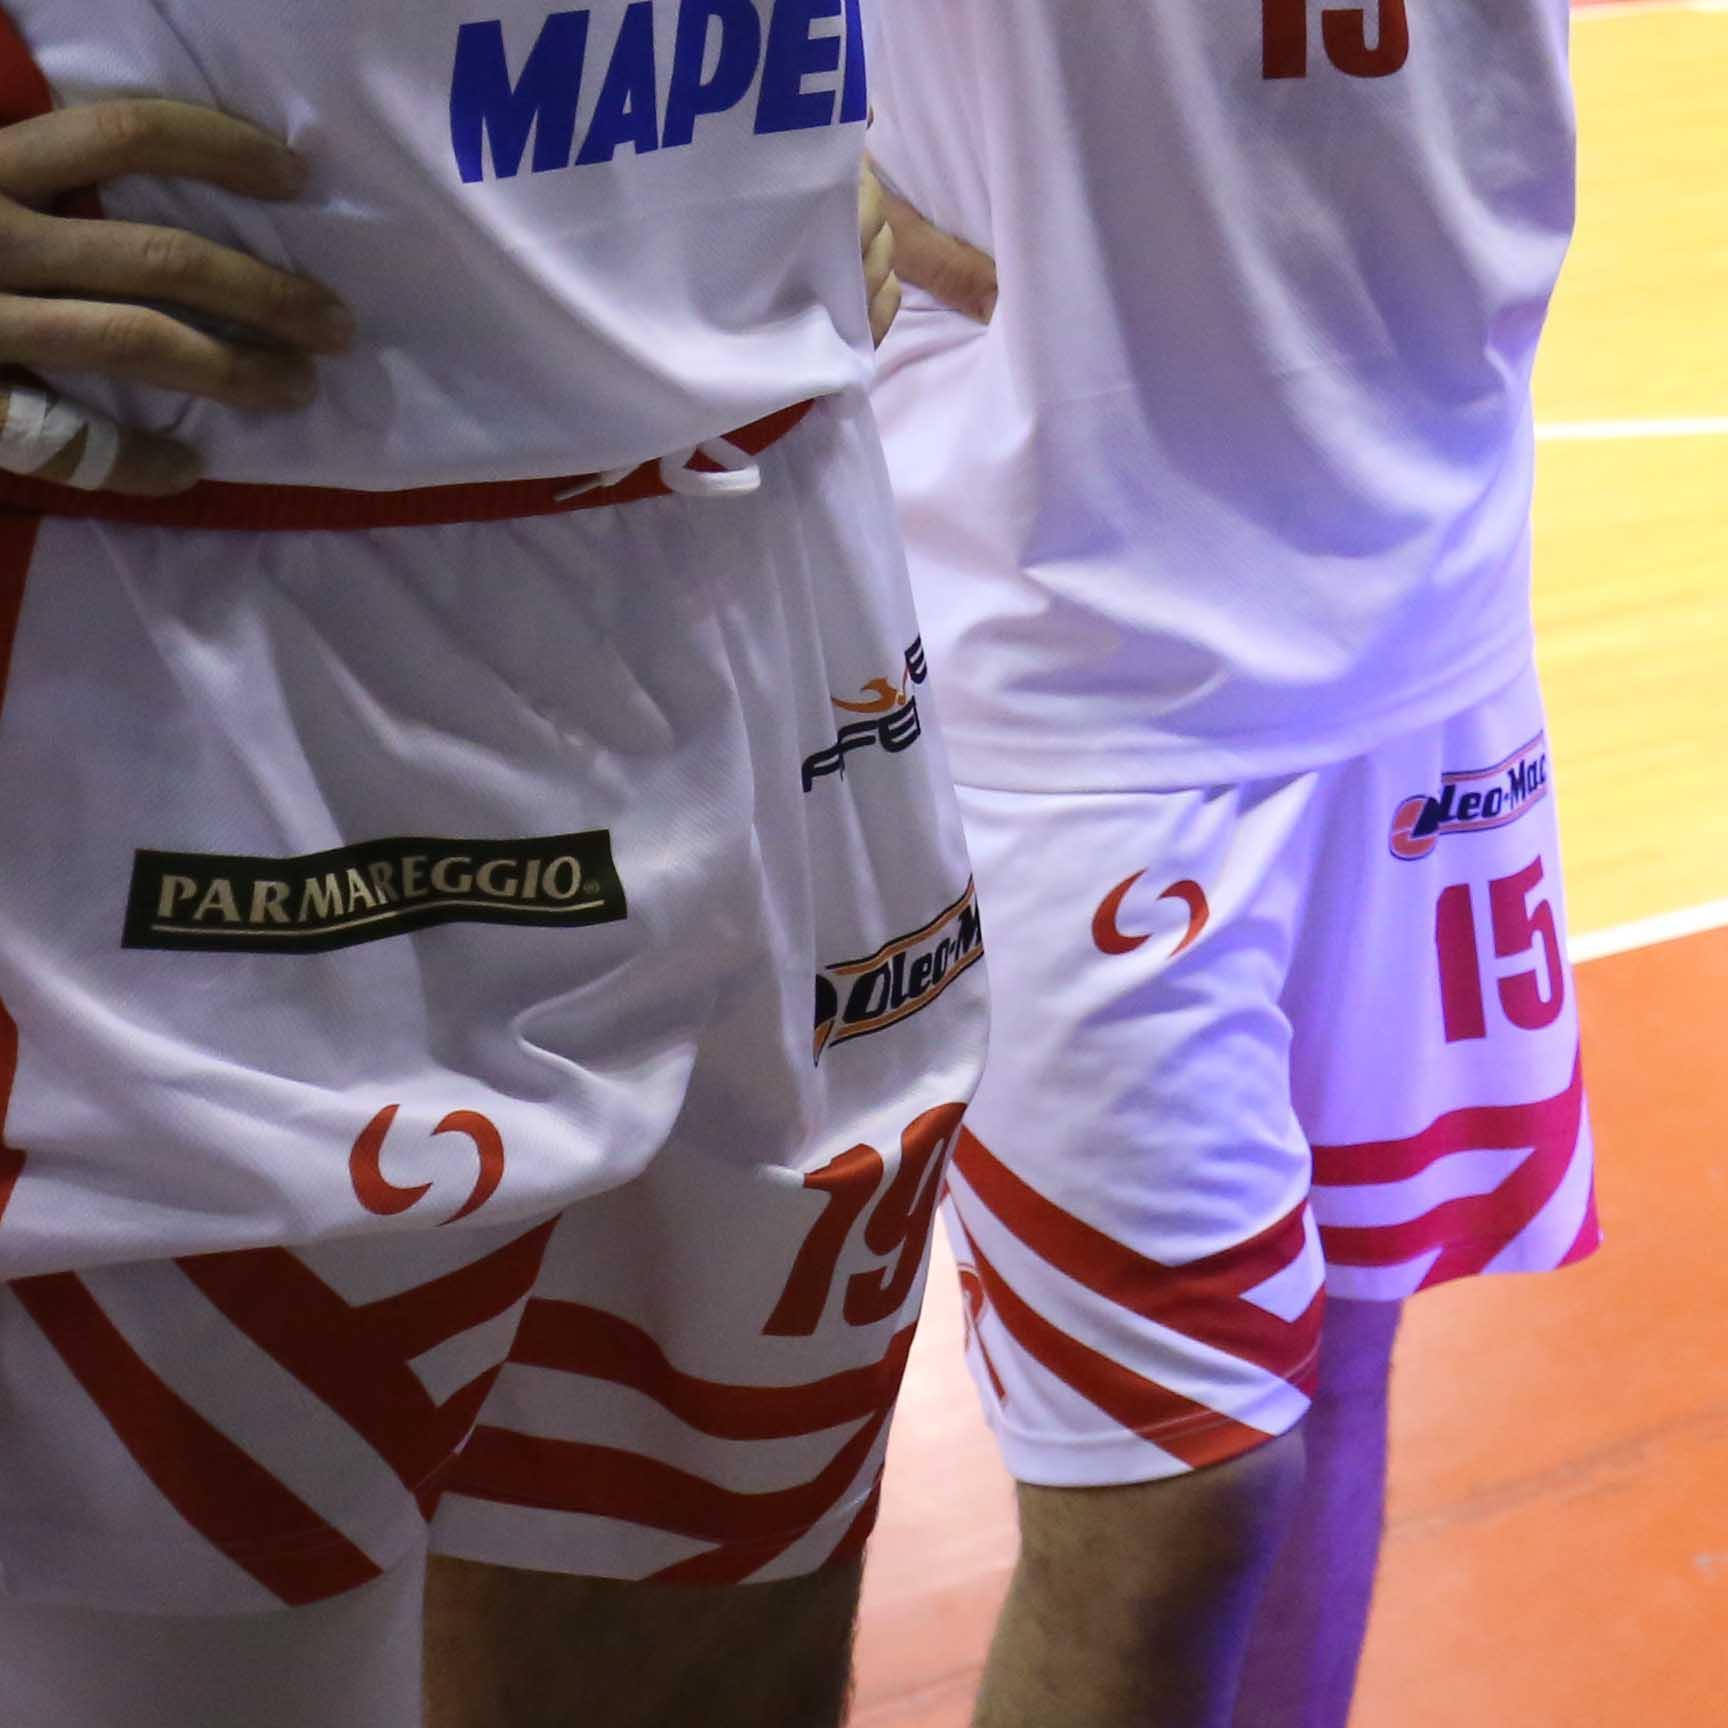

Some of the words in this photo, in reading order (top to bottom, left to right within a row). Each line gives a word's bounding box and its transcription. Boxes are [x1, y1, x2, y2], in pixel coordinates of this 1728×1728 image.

[156, 855, 583, 925] PARMAREGGIO
[1434, 854, 1564, 1044] 15
[762, 1101, 967, 1338] 19
